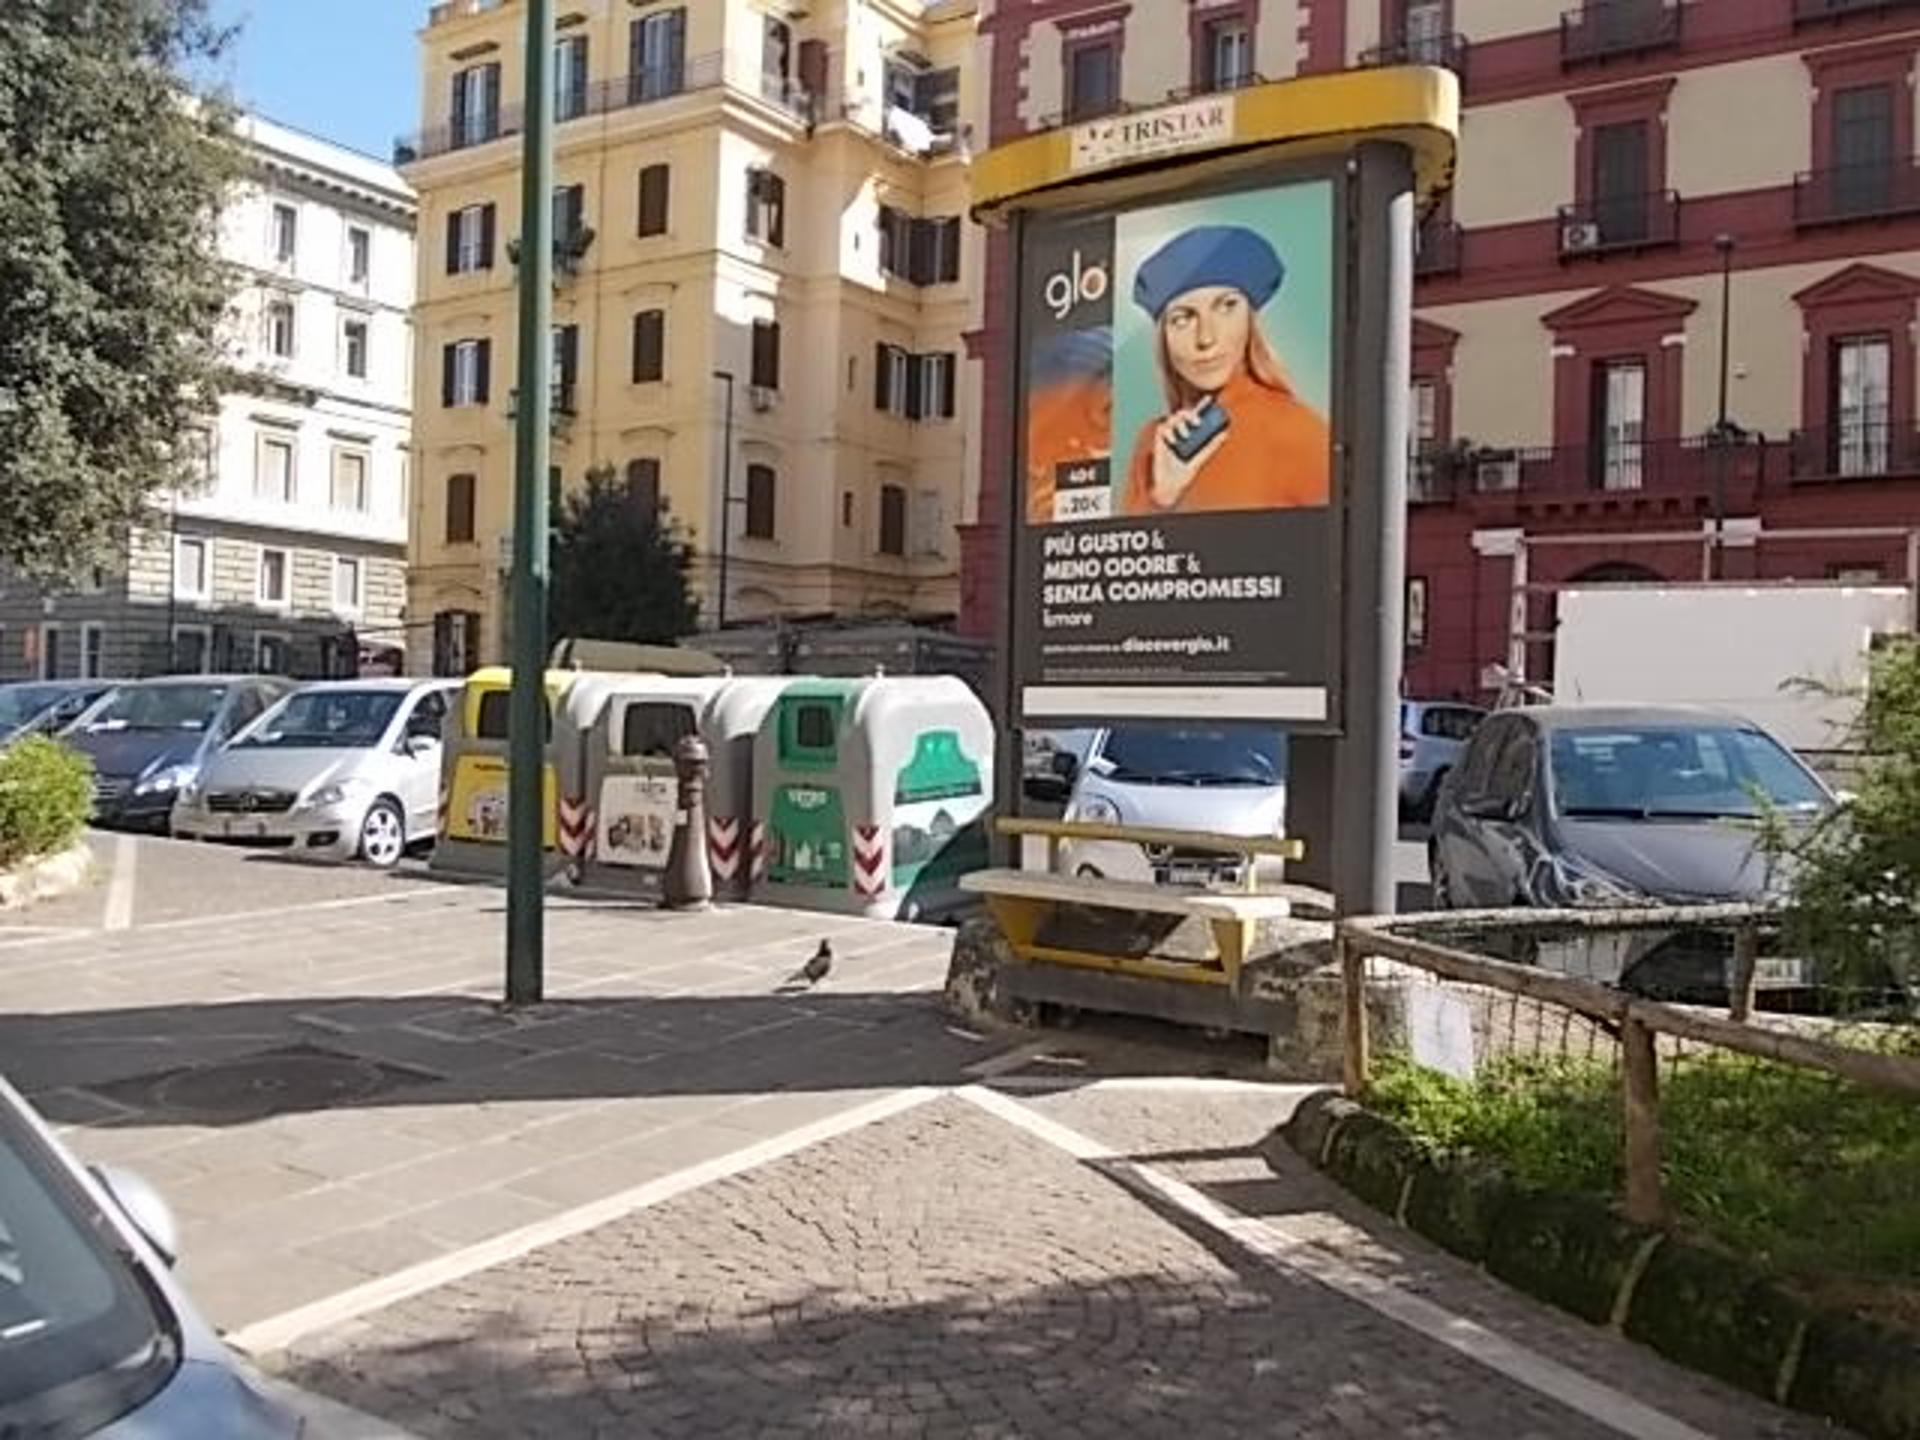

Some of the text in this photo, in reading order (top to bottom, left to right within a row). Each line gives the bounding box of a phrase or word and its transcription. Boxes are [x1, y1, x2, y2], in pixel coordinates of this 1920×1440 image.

[1122, 107, 1224, 143] TRISTAR
[1046, 249, 1107, 319] glo
[1044, 530, 1165, 556] PIÙ GUSTO &
[1044, 558, 1100, 580] MENO
[1187, 553, 1201, 574] &
[1043, 577, 1281, 604] SENZA COMPROMESSI
